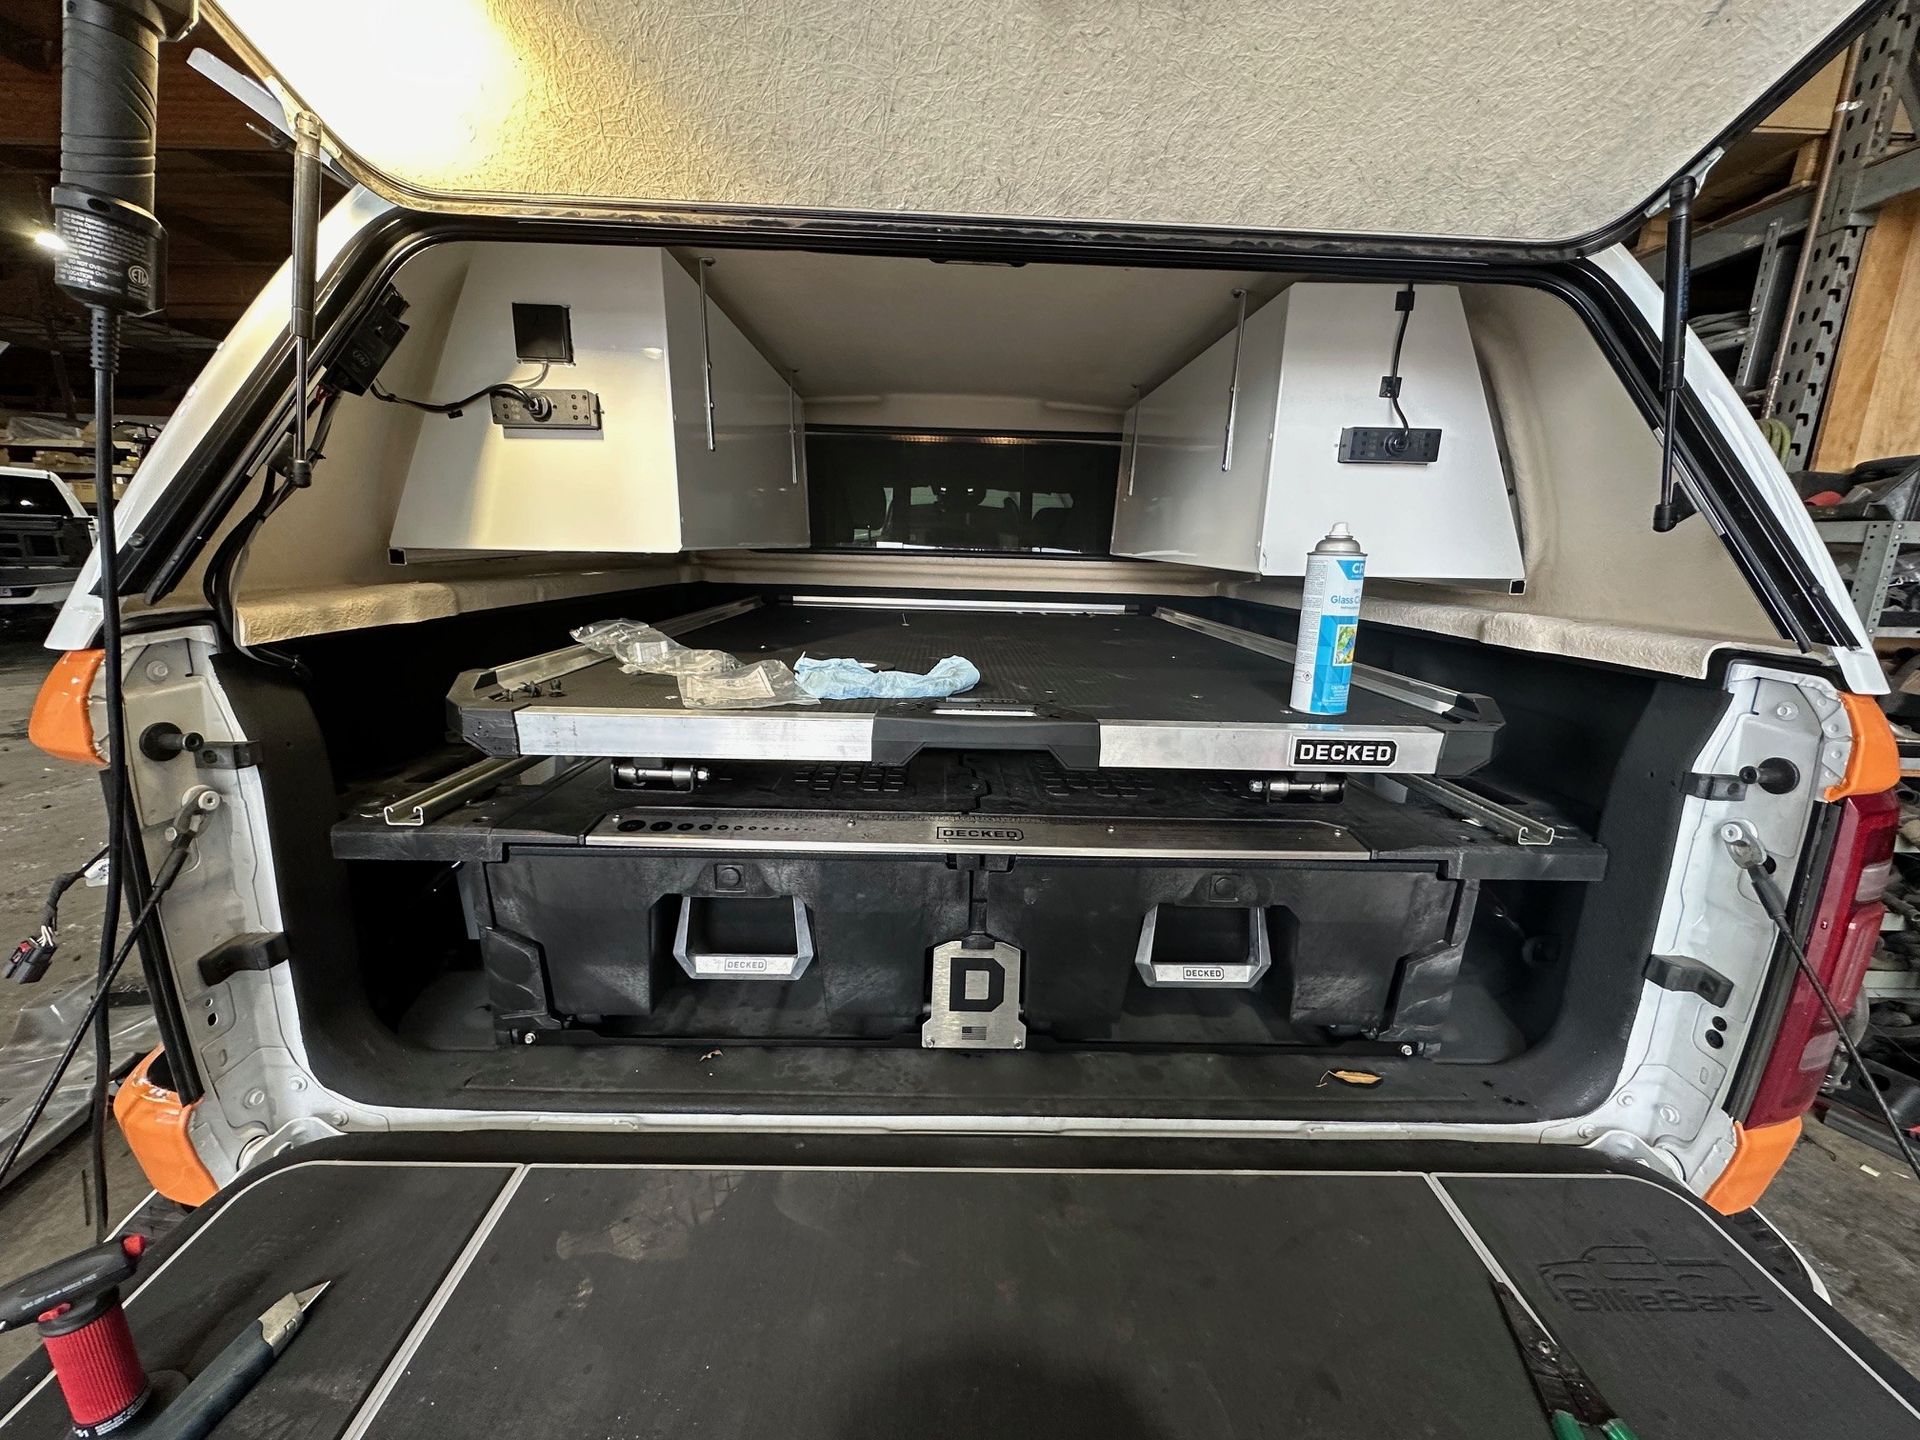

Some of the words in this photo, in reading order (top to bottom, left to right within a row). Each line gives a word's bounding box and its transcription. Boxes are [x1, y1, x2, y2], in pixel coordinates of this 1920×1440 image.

[1330, 594, 1354, 605] Glass
[1299, 743, 1392, 761] DECKED
[943, 829, 1018, 839] DECKED
[727, 961, 765, 969] DECKED
[1185, 969, 1222, 978] DECKED
[949, 957, 1006, 1012] D
